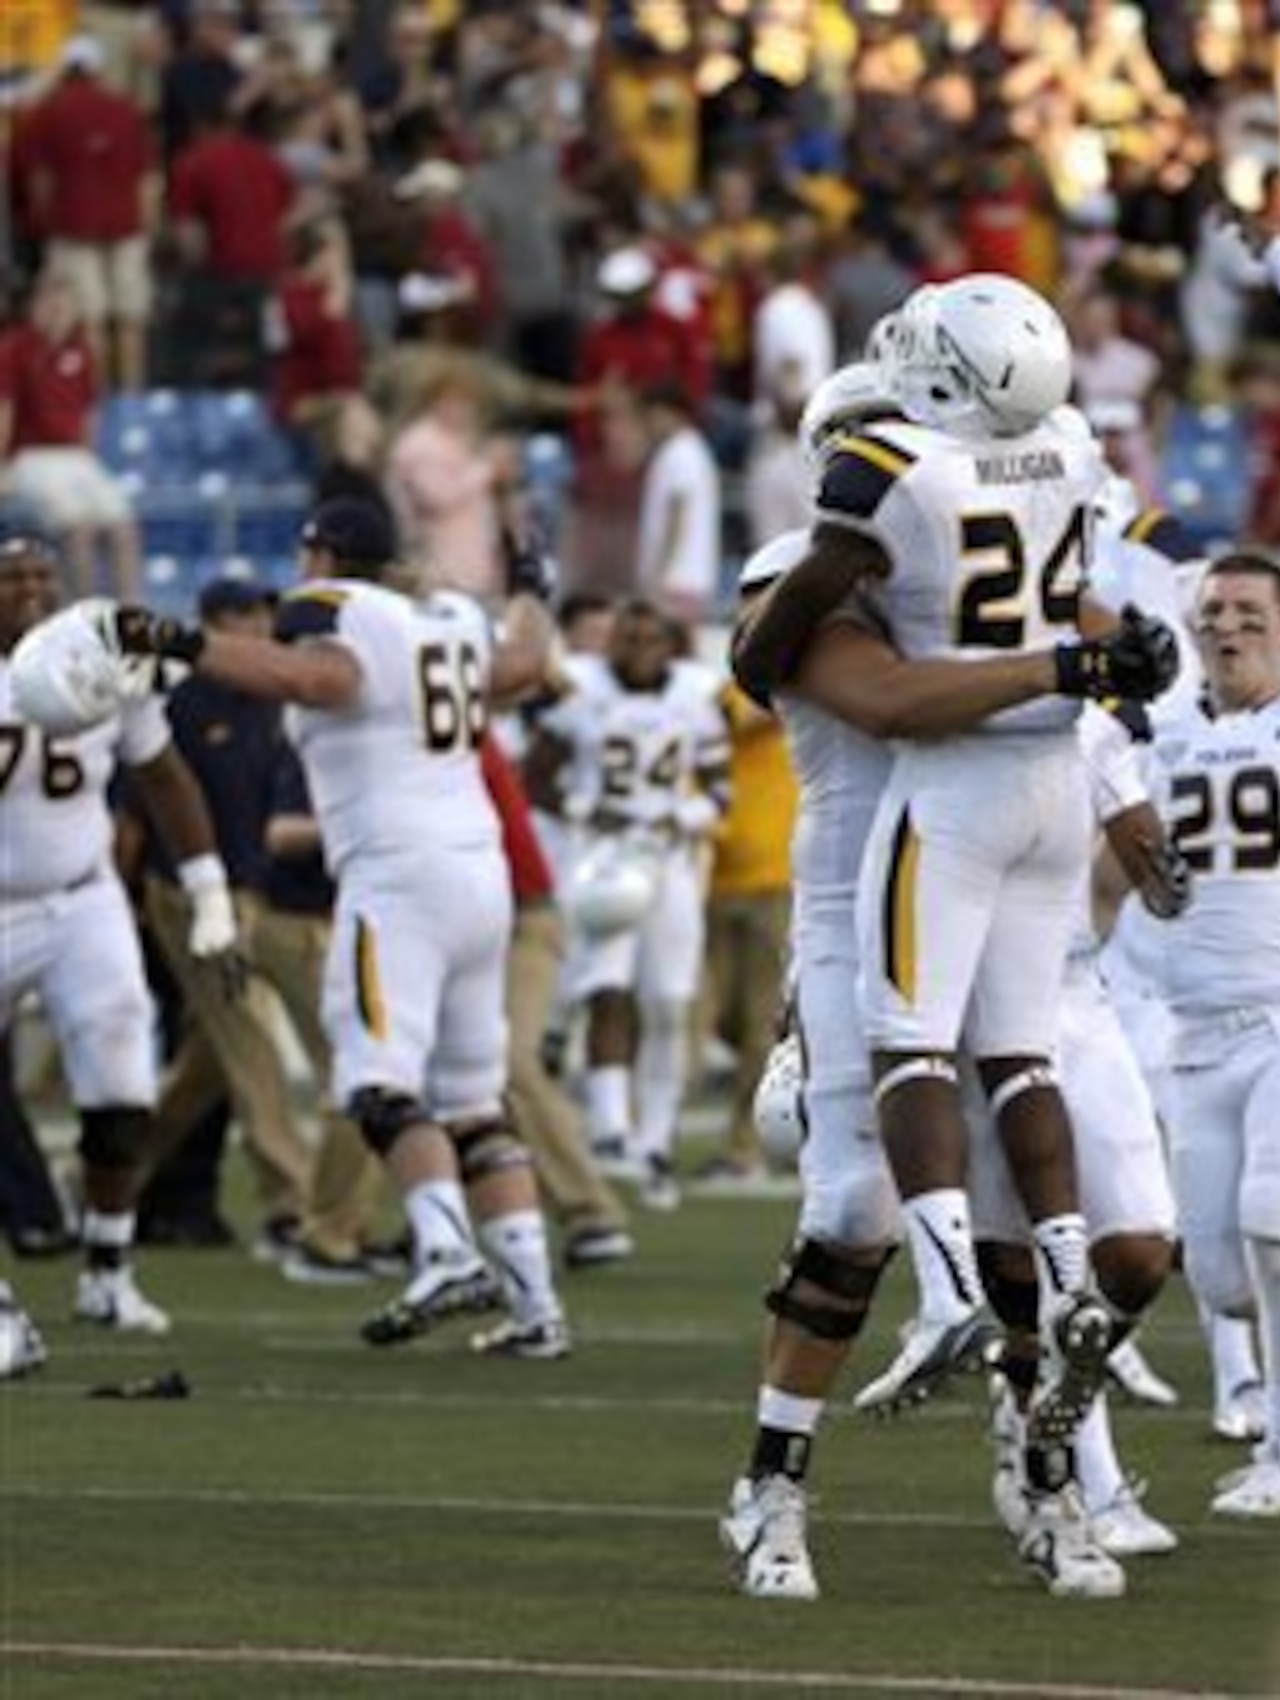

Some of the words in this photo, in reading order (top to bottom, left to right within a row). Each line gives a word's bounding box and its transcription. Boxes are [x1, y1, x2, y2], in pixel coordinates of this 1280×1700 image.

[975, 451, 1065, 485] MILLIGAN
[957, 504, 1090, 648] 24
[602, 735, 682, 797] 24
